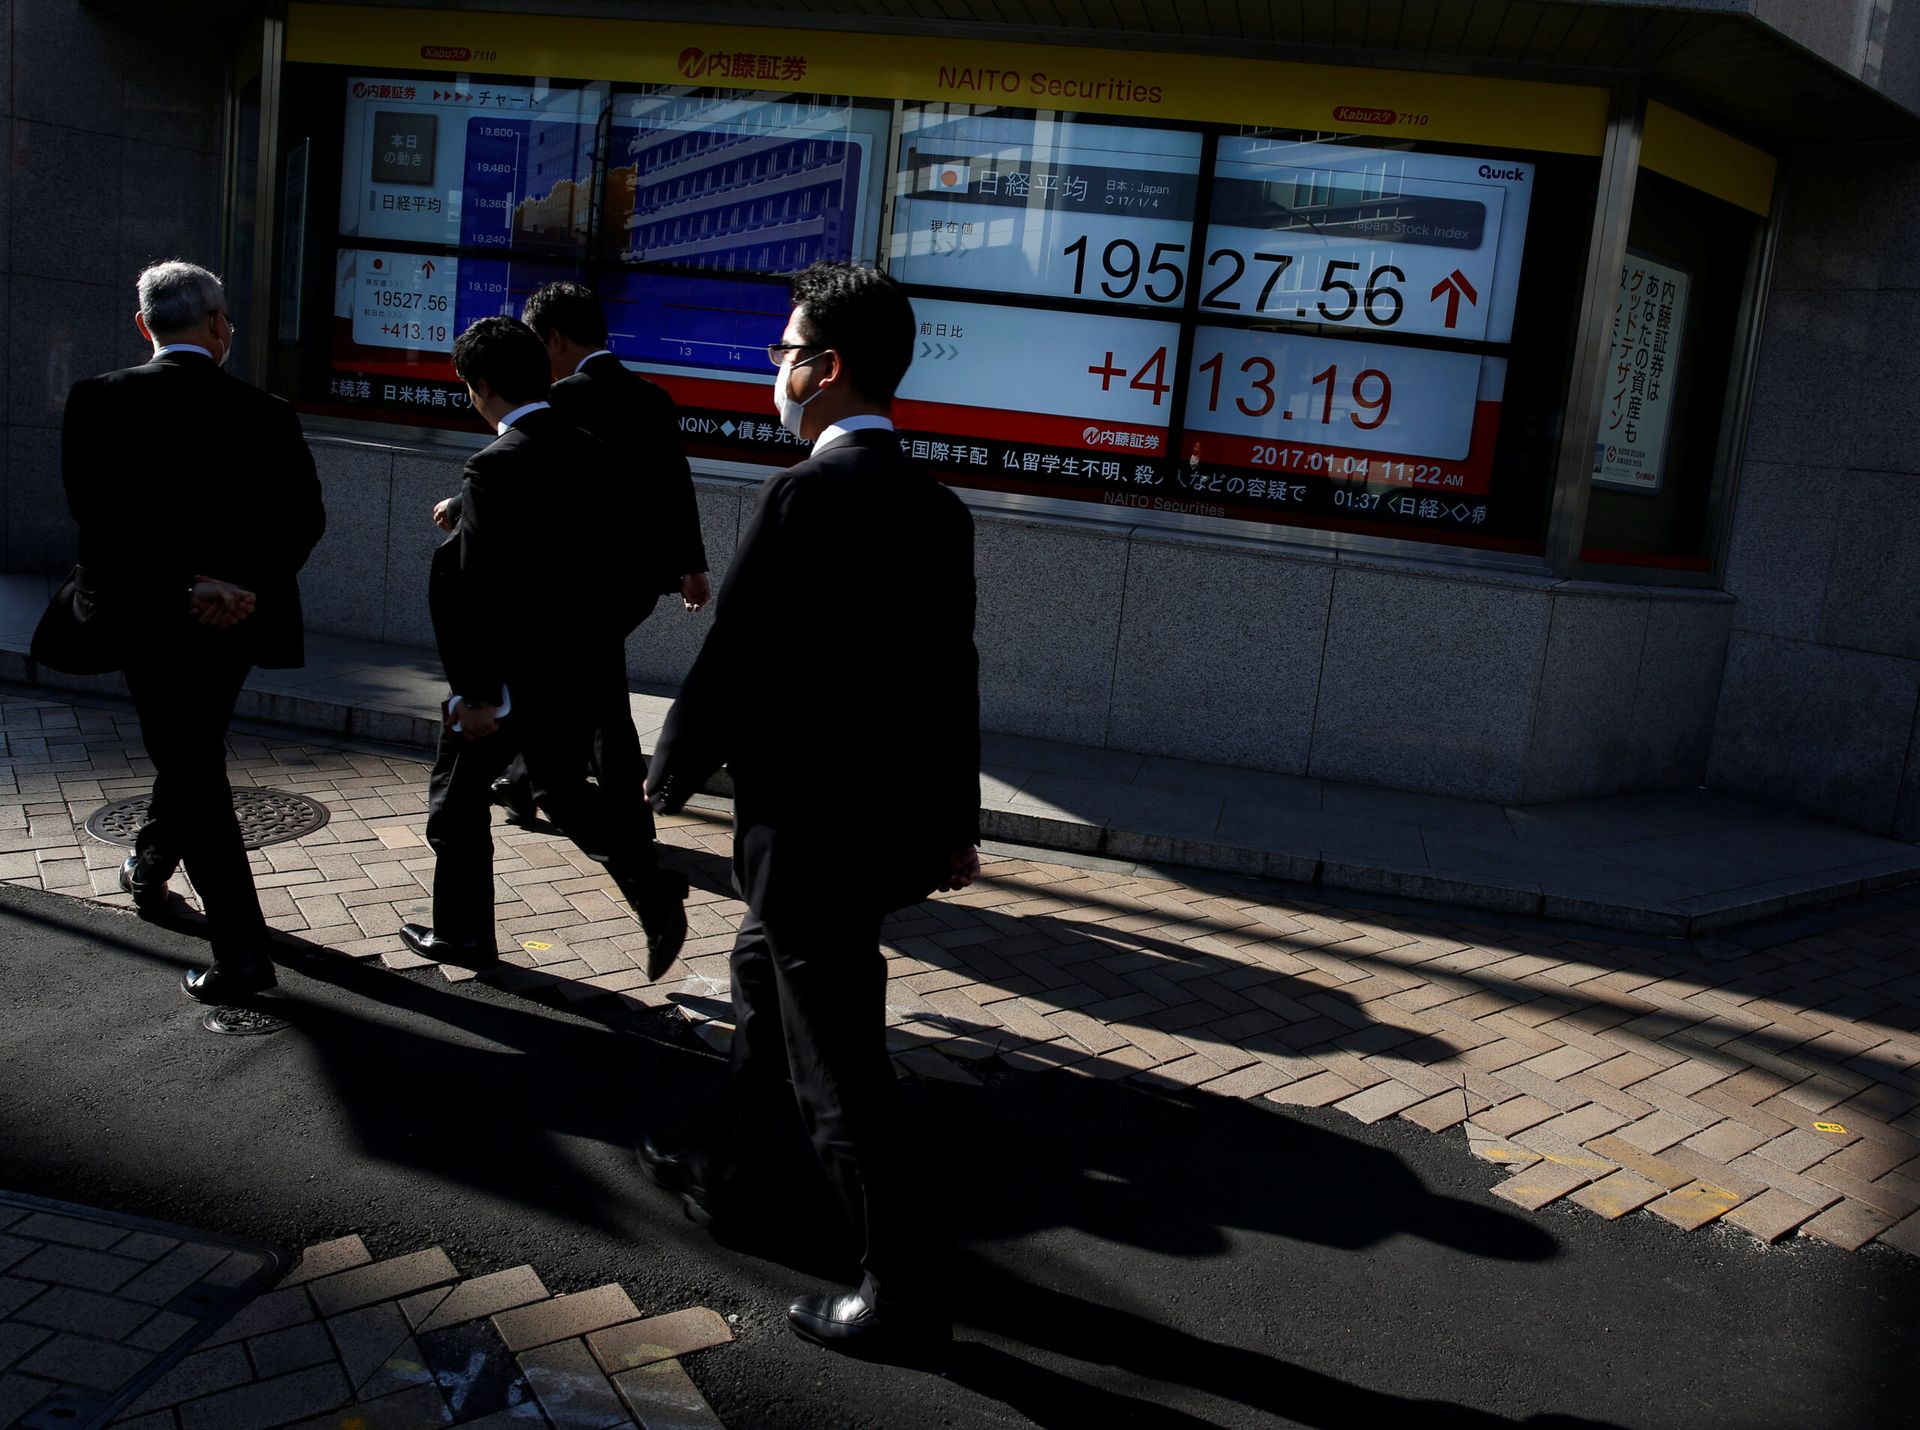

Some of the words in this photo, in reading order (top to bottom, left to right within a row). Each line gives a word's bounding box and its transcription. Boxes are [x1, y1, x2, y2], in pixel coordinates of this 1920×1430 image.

[708, 52, 807, 81] 内藤証券
[938, 66, 1021, 93] NAITO
[1030, 72, 1162, 104] Securities
[366, 83, 417, 100] 内藤証券
[478, 90, 540, 108] チャート
[1398, 113, 1429, 126] 7110
[391, 133, 418, 149] 本日
[479, 127, 514, 139] 19,600
[384, 151, 424, 168] の動き
[476, 162, 511, 174] 19,480
[978, 170, 1089, 202] 日経平均
[382, 193, 442, 214] 日経平均
[474, 198, 509, 209] 19,360
[930, 218, 974, 236] 現在値
[1392, 221, 1430, 237] Stock
[1433, 225, 1471, 241] Index
[472, 233, 507, 245] 19,240
[468, 282, 503, 293] 19,120
[374, 290, 448, 312] 19527.56
[380, 322, 446, 342] +413.19
[920, 322, 964, 339] 前日比
[1647, 280, 1676, 401] 内藤証券は
[678, 346, 692, 357] 13
[727, 351, 741, 361] 14
[1609, 270, 1645, 430] グッドデザイン
[1625, 274, 1660, 443] あなたの資産も
[1100, 430, 1160, 450] 内藤証券
[1250, 445, 1369, 477] 2017.01.04
[1382, 460, 1441, 486] 11:22
[1442, 474, 1464, 488] AM
[1104, 490, 1149, 508] NAITO
[1153, 496, 1225, 518] Securities
[1334, 489, 1380, 511] 01:37
